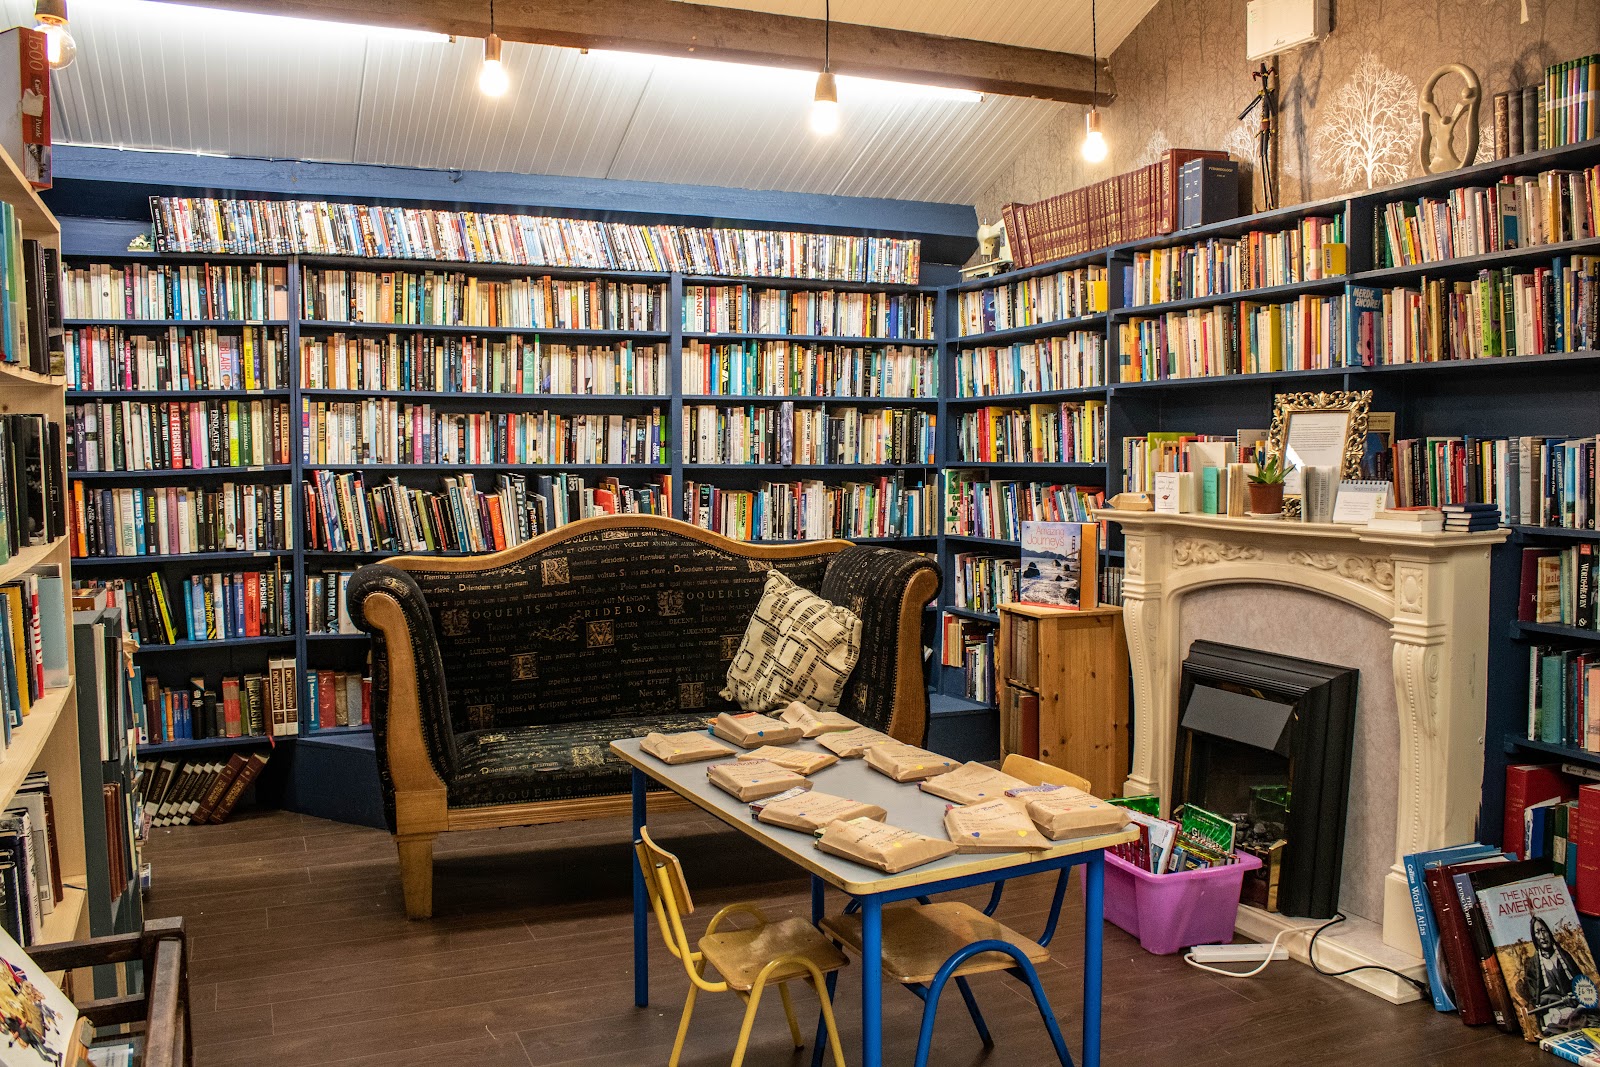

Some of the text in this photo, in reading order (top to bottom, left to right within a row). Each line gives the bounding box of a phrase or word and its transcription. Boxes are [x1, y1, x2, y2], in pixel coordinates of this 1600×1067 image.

[29, 33, 44, 71] 1500
[1353, 287, 1374, 299] MERDE
[220, 346, 232, 371] BLAIR
[523, 353, 532, 377] KATE
[171, 404, 182, 457] ALEX FERGUSON
[211, 409, 220, 452] FINDLATERS
[318, 423, 326, 442] MARTIN
[394, 481, 404, 520] PHOTOGRAPHY
[1027, 535, 1065, 548] Journeys
[1036, 525, 1065, 537] Amazing
[686, 589, 750, 600] OQUERIS
[285, 670, 293, 709] DICTIONARY
[676, 672, 715, 683] ANIMI
[273, 671, 281, 710] DICTIONARY
[1407, 863, 1427, 936] Collins World Atlas
[1457, 882, 1473, 926] LIVING WORLD
[1498, 893, 1565, 916] AMERICANS
[1500, 884, 1554, 901] THE NATIVE
[1555, 1048, 1578, 1065] ATLAS
